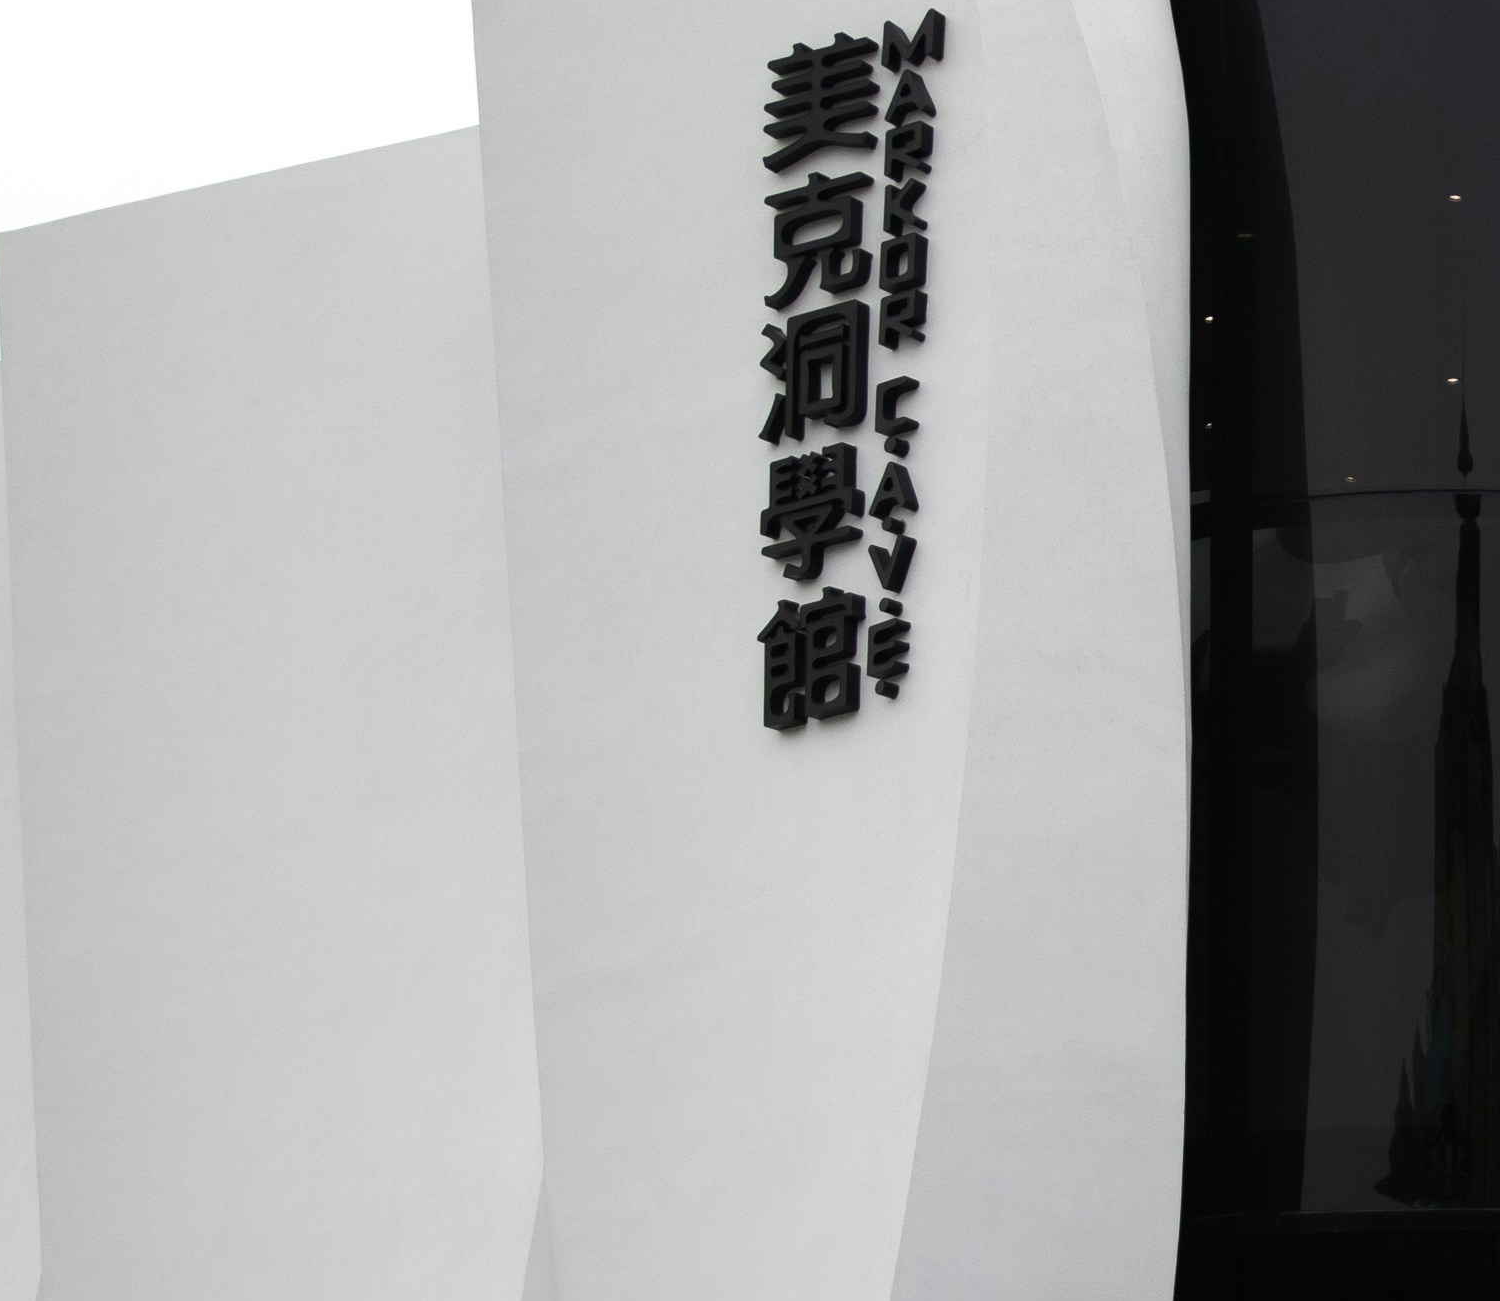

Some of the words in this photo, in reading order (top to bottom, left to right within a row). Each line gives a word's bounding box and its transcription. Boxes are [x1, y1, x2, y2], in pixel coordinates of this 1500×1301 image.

[757, 32, 880, 732] 美克洞學館
[878, 8, 945, 350] MARKOR
